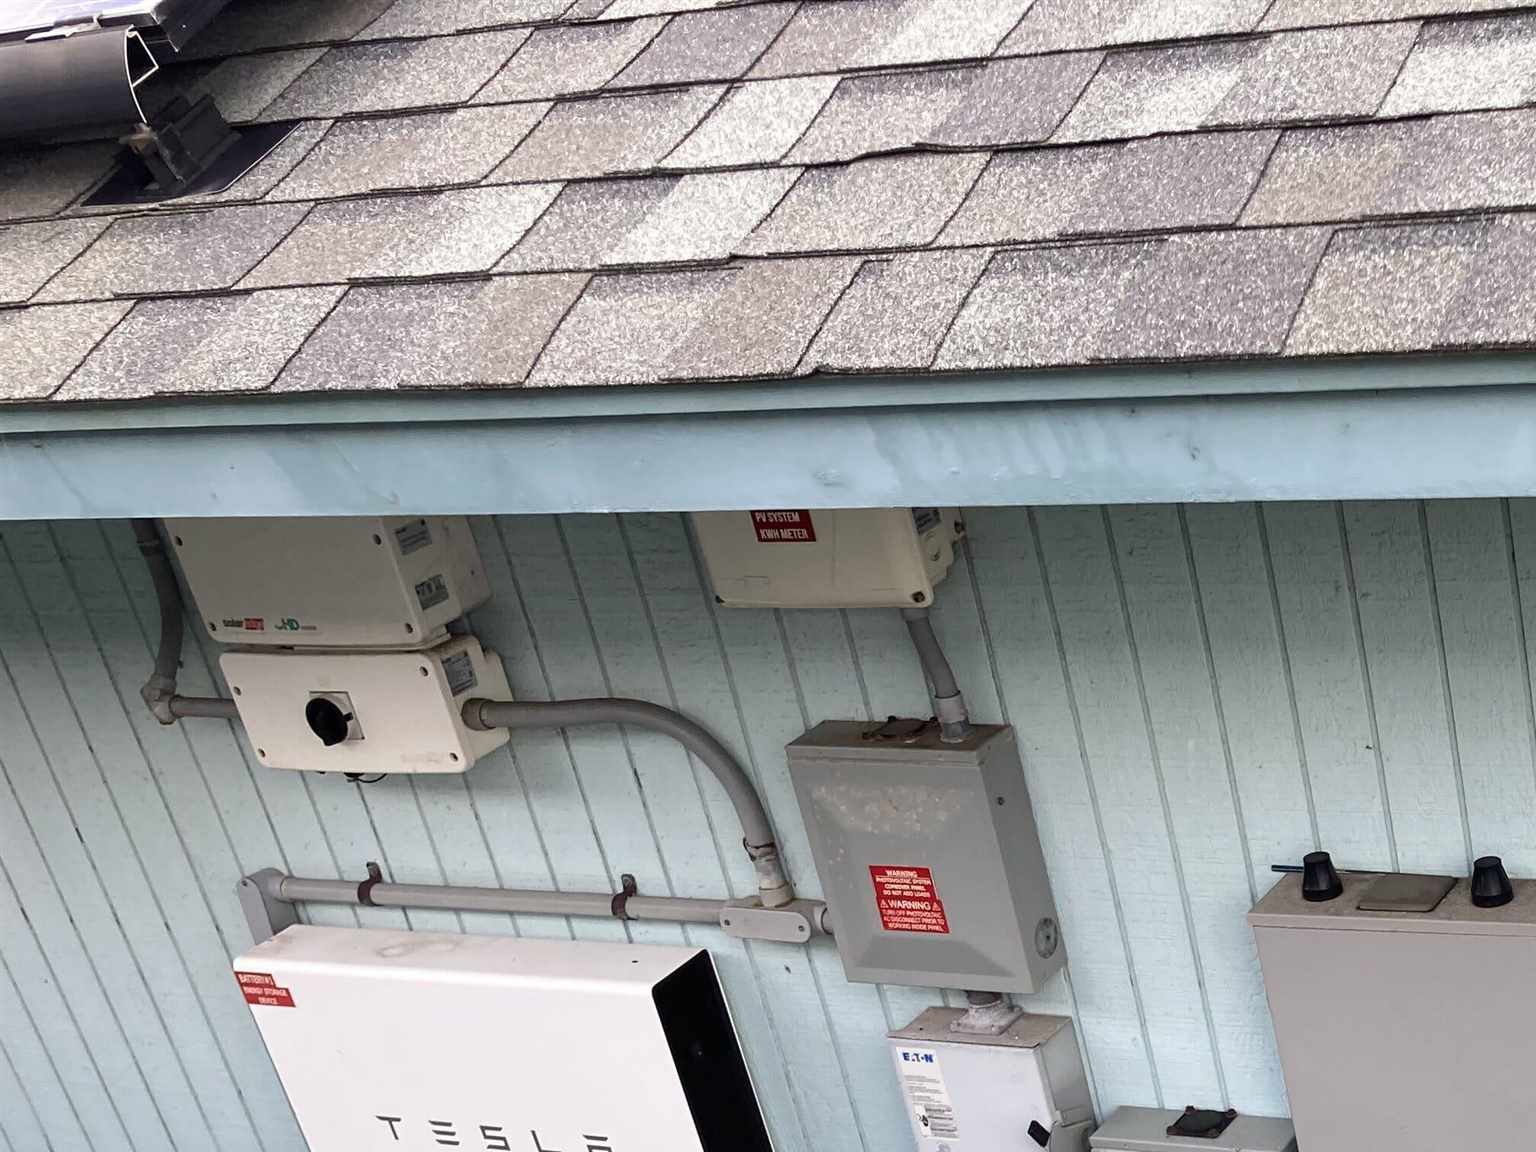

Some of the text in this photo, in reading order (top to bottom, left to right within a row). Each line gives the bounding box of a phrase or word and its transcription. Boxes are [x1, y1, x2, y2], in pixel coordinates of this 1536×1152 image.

[755, 512, 800, 522] PV SYSTEM
[760, 529, 808, 539] KWH METER
[885, 870, 918, 878] WARNING
[888, 900, 931, 911] WARNING
